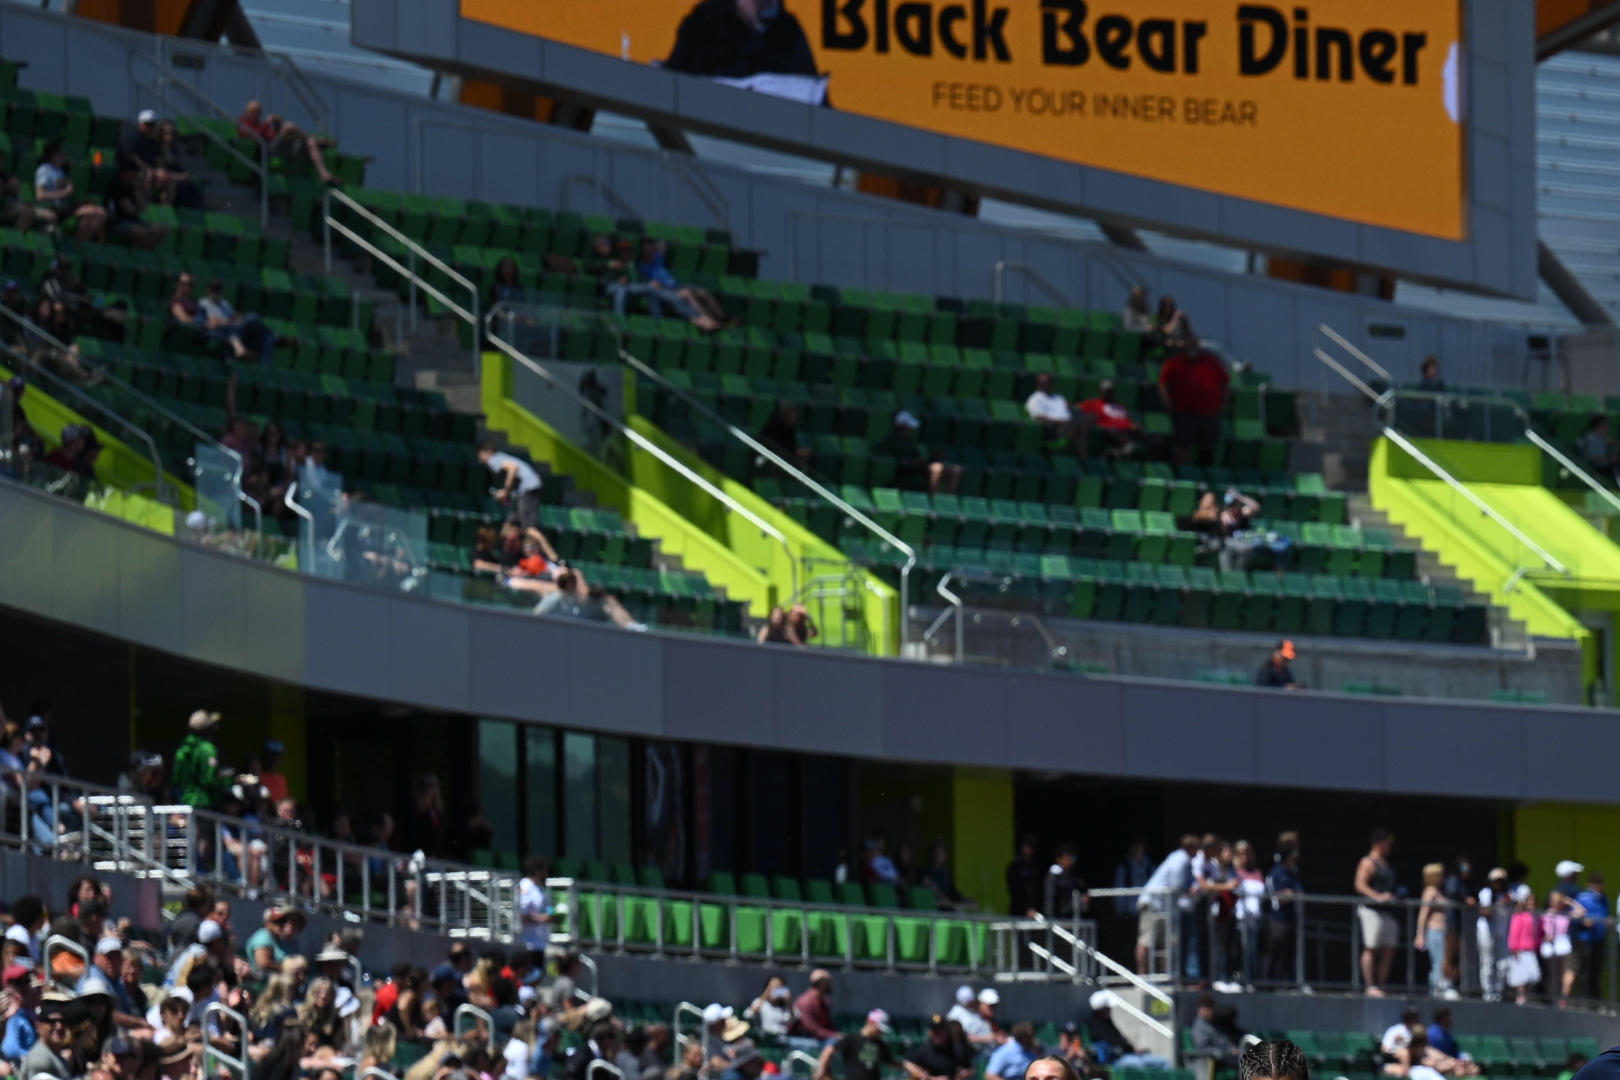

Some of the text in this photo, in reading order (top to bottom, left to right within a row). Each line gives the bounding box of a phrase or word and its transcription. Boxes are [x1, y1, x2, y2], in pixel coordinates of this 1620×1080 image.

[821, 0, 1428, 86] Black Bear Diner
[932, 81, 1259, 127] FEED YOUR INNER BEAR
